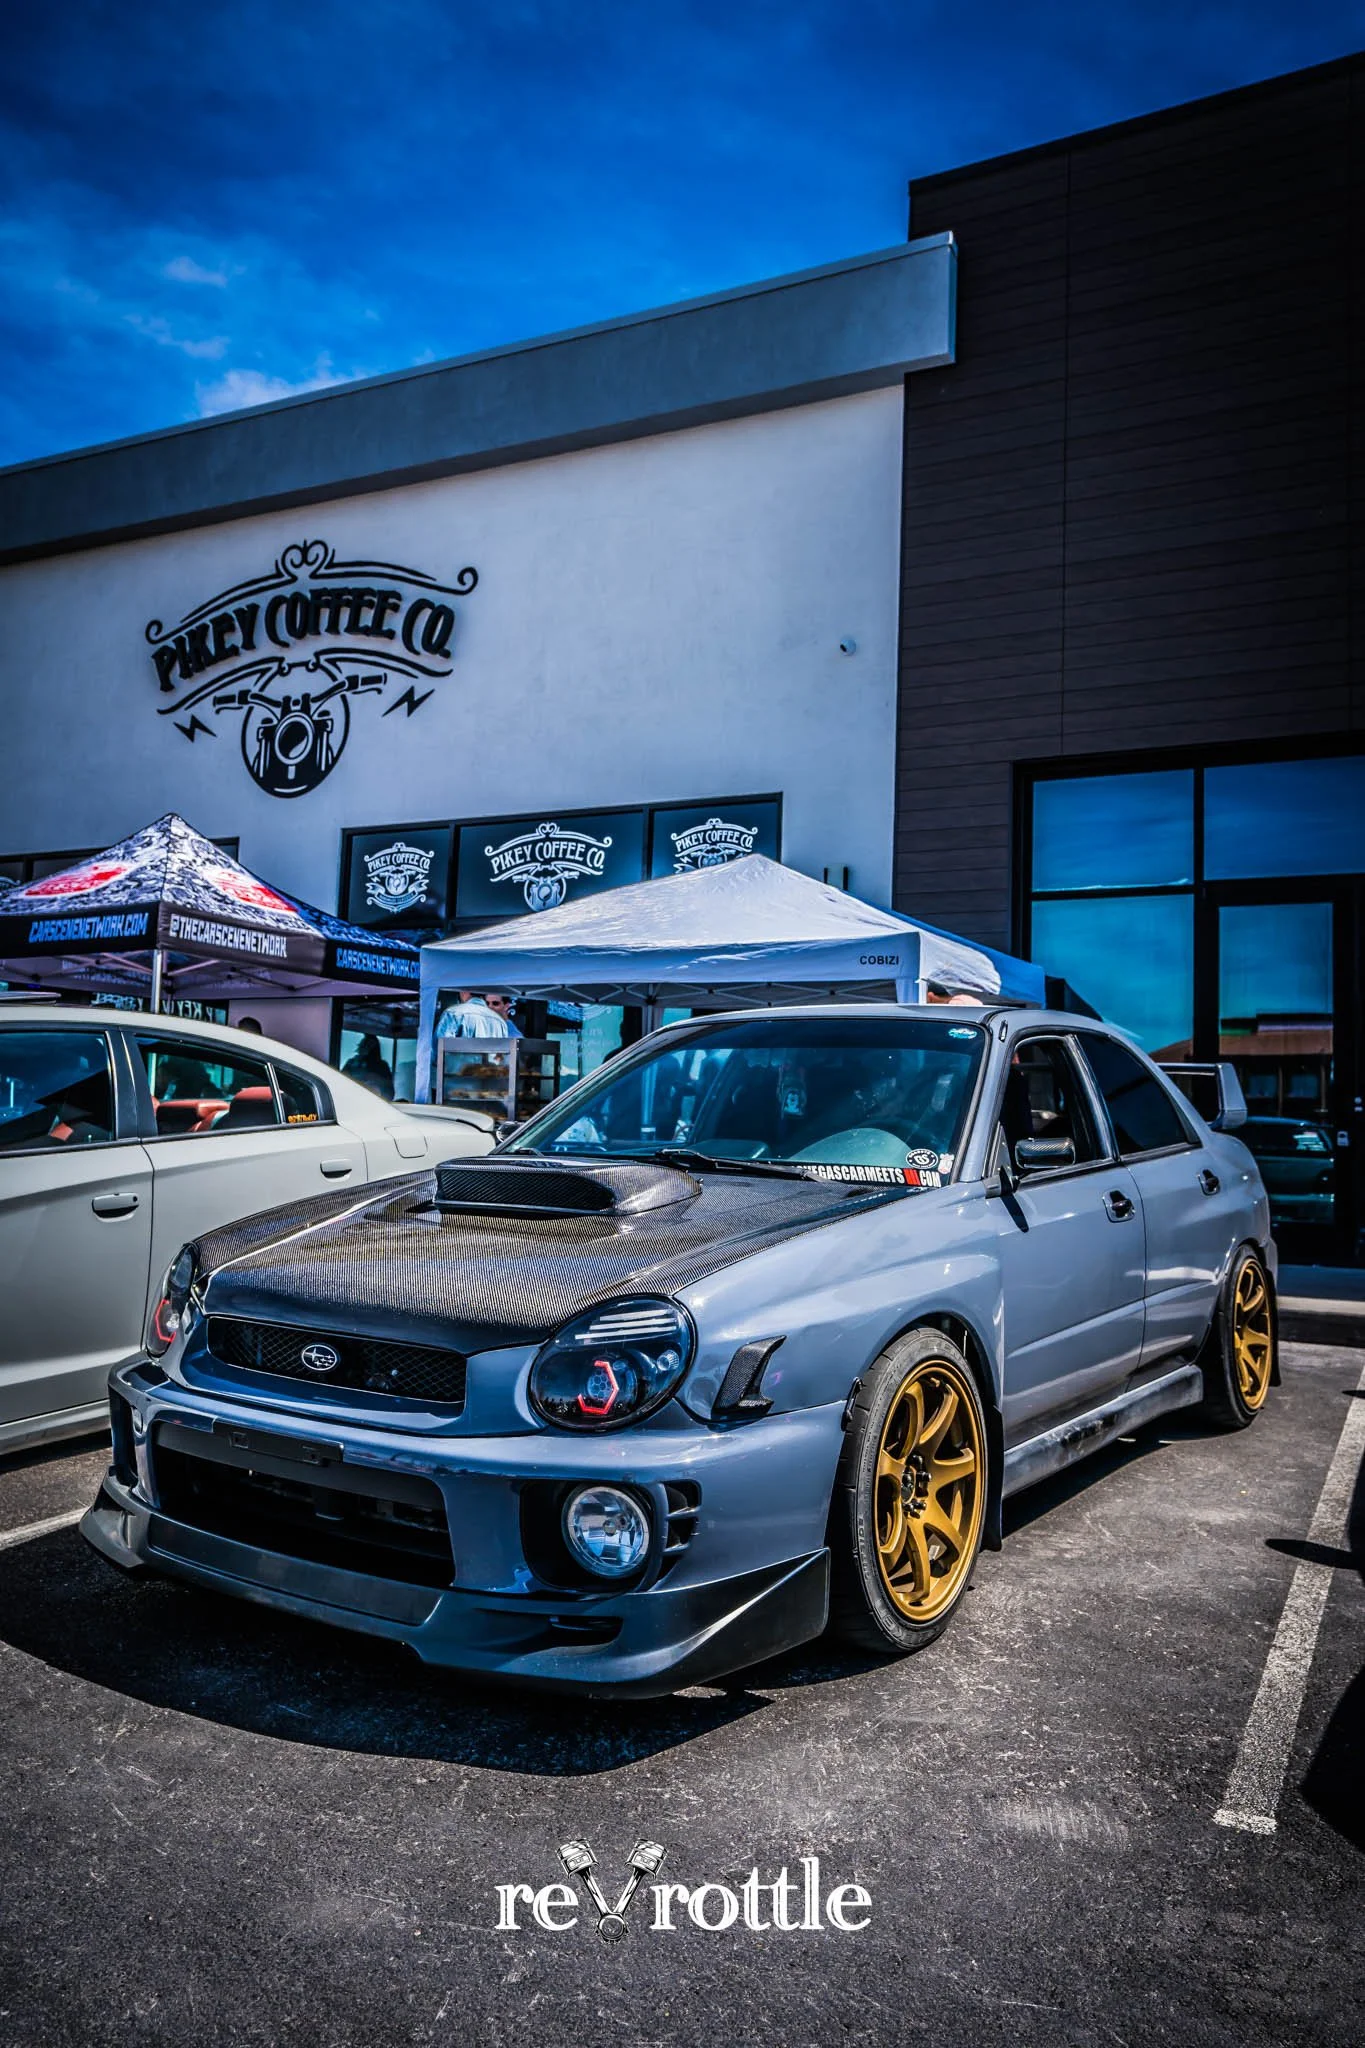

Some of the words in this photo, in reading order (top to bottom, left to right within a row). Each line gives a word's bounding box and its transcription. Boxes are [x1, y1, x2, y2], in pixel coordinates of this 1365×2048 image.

[151, 602, 260, 692] PIKEY
[264, 586, 404, 648] COFFEE
[675, 832, 704, 852] PIKEY
[705, 830, 740, 844] COFFEE
[367, 854, 391, 872] PIKEY
[391, 852, 420, 865] COFFEE
[491, 844, 533, 874] PIKEY
[535, 841, 586, 862] COFFEE
[169, 913, 287, 958] @THECARSCENENETWORK
[859, 955, 899, 966] COBIZI
